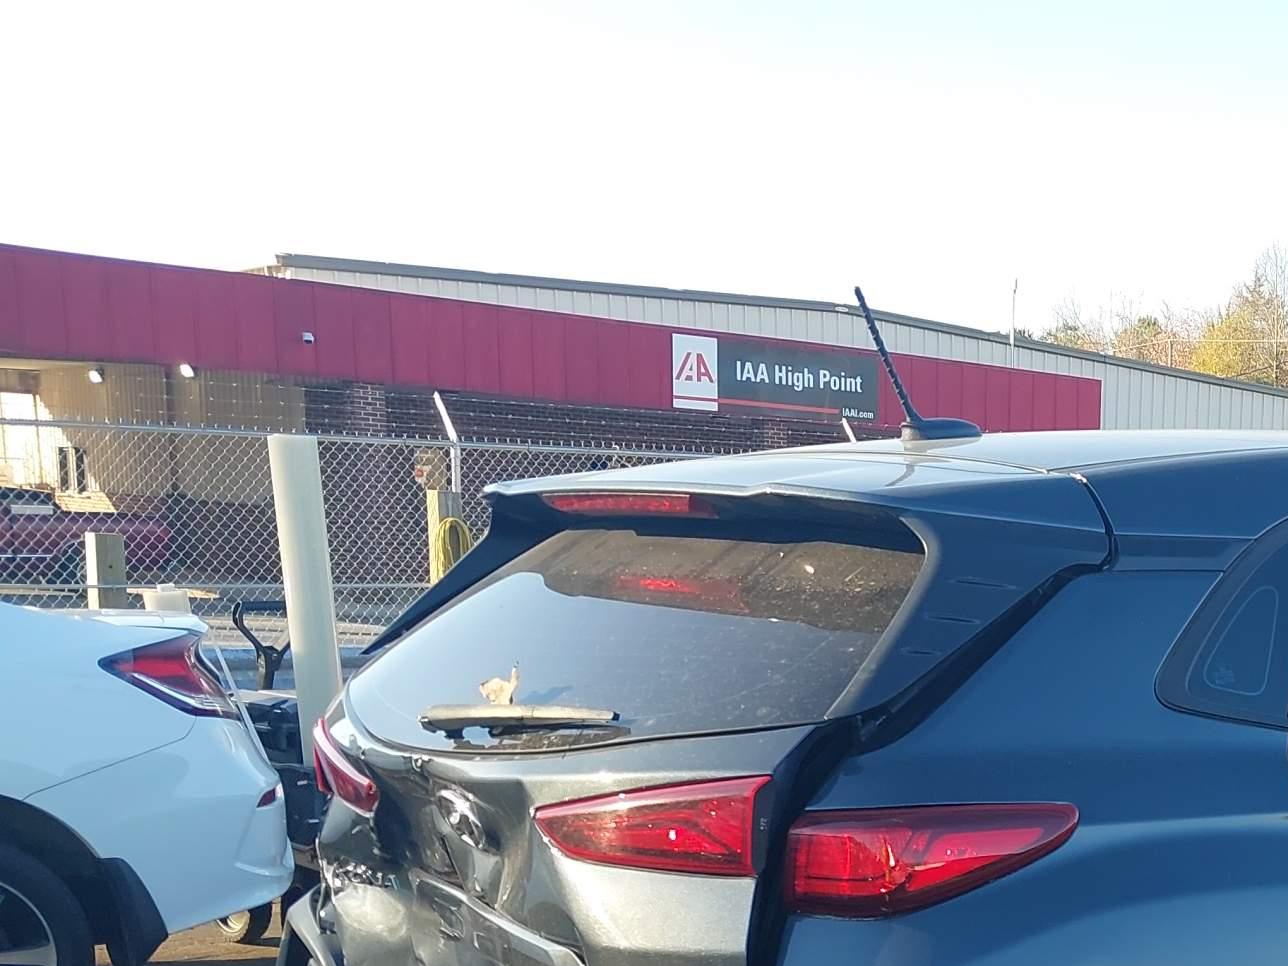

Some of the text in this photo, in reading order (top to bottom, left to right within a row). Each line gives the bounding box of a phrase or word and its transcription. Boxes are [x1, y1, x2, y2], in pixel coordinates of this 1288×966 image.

[736, 360, 863, 392] IAA High Point
